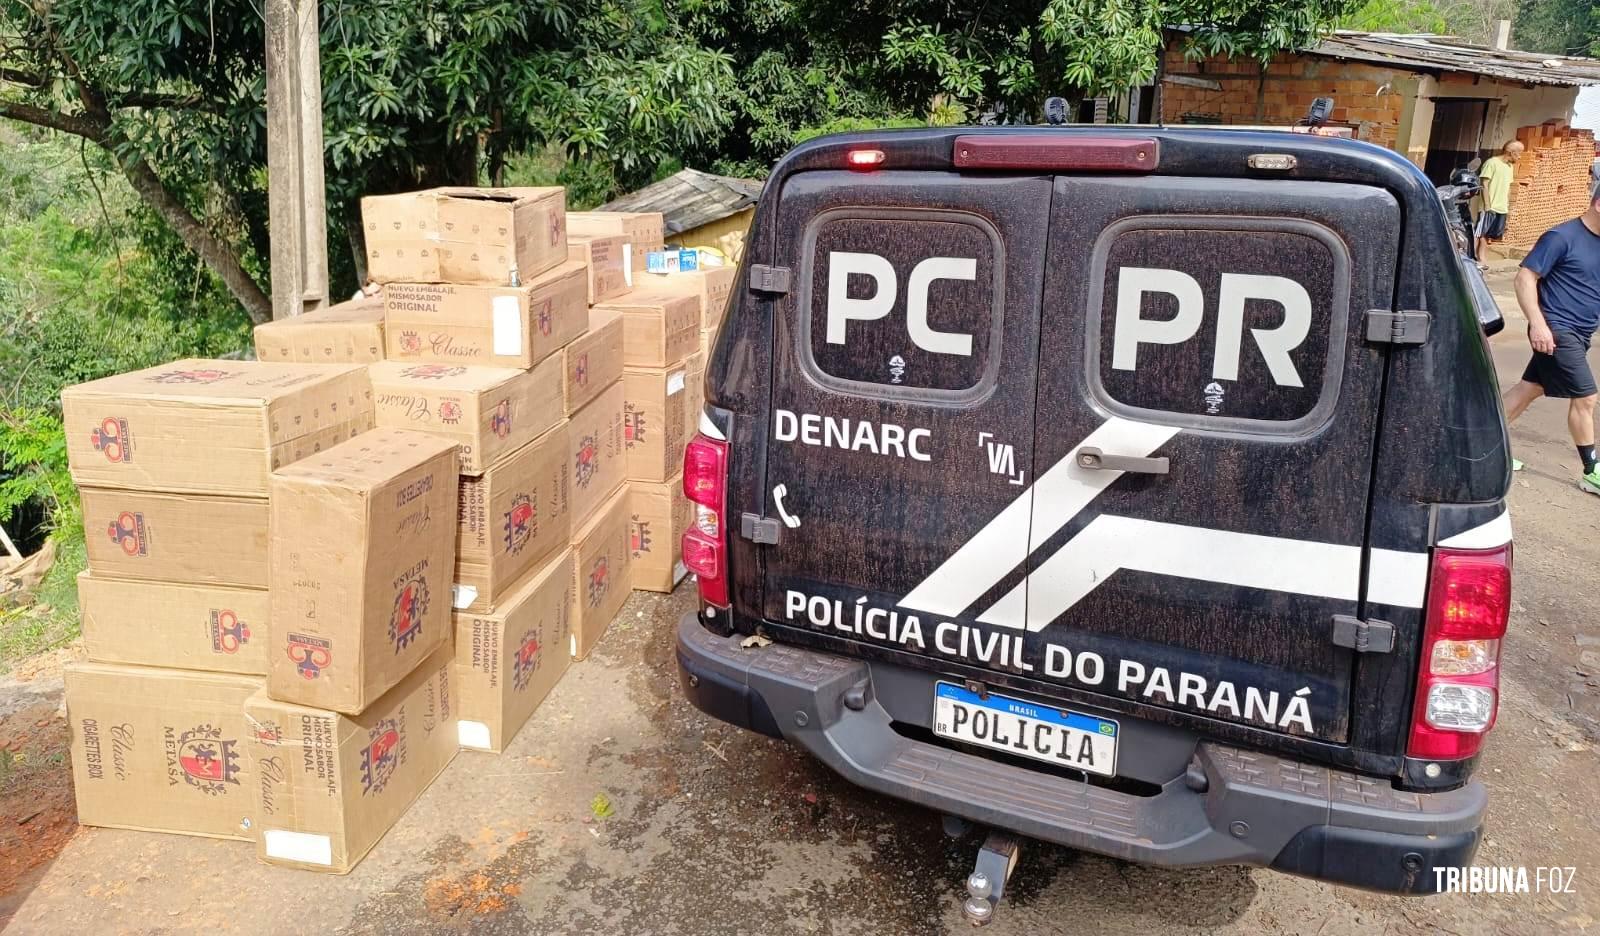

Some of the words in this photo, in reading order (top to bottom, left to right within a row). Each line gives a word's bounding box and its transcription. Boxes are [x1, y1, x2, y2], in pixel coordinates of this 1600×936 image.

[388, 302, 438, 313] ORIGINAL
[826, 251, 977, 356] PC
[1112, 267, 1312, 388] PR
[428, 331, 481, 358] Classic
[376, 393, 431, 424] Classic
[775, 409, 932, 461] DENARC
[393, 558, 430, 590] METASA
[472, 618, 482, 669] ORIGINAL
[786, 588, 926, 649] POLÍCIA
[934, 621, 1034, 673] CIVIL
[1045, 644, 1104, 685] DO
[1118, 658, 1314, 733] PARANÁ
[323, 716, 333, 748] NUEVO
[937, 722, 947, 733] BR
[952, 704, 1095, 766] POLICIA
[1009, 704, 1038, 718] BRASIL
[82, 718, 101, 764] CIGARETTES
[110, 723, 135, 782] Classic
[163, 726, 179, 787] METASA
[302, 714, 315, 773] ORIGINAL
[88, 763, 104, 780] BOX
[259, 755, 285, 816] Classic
